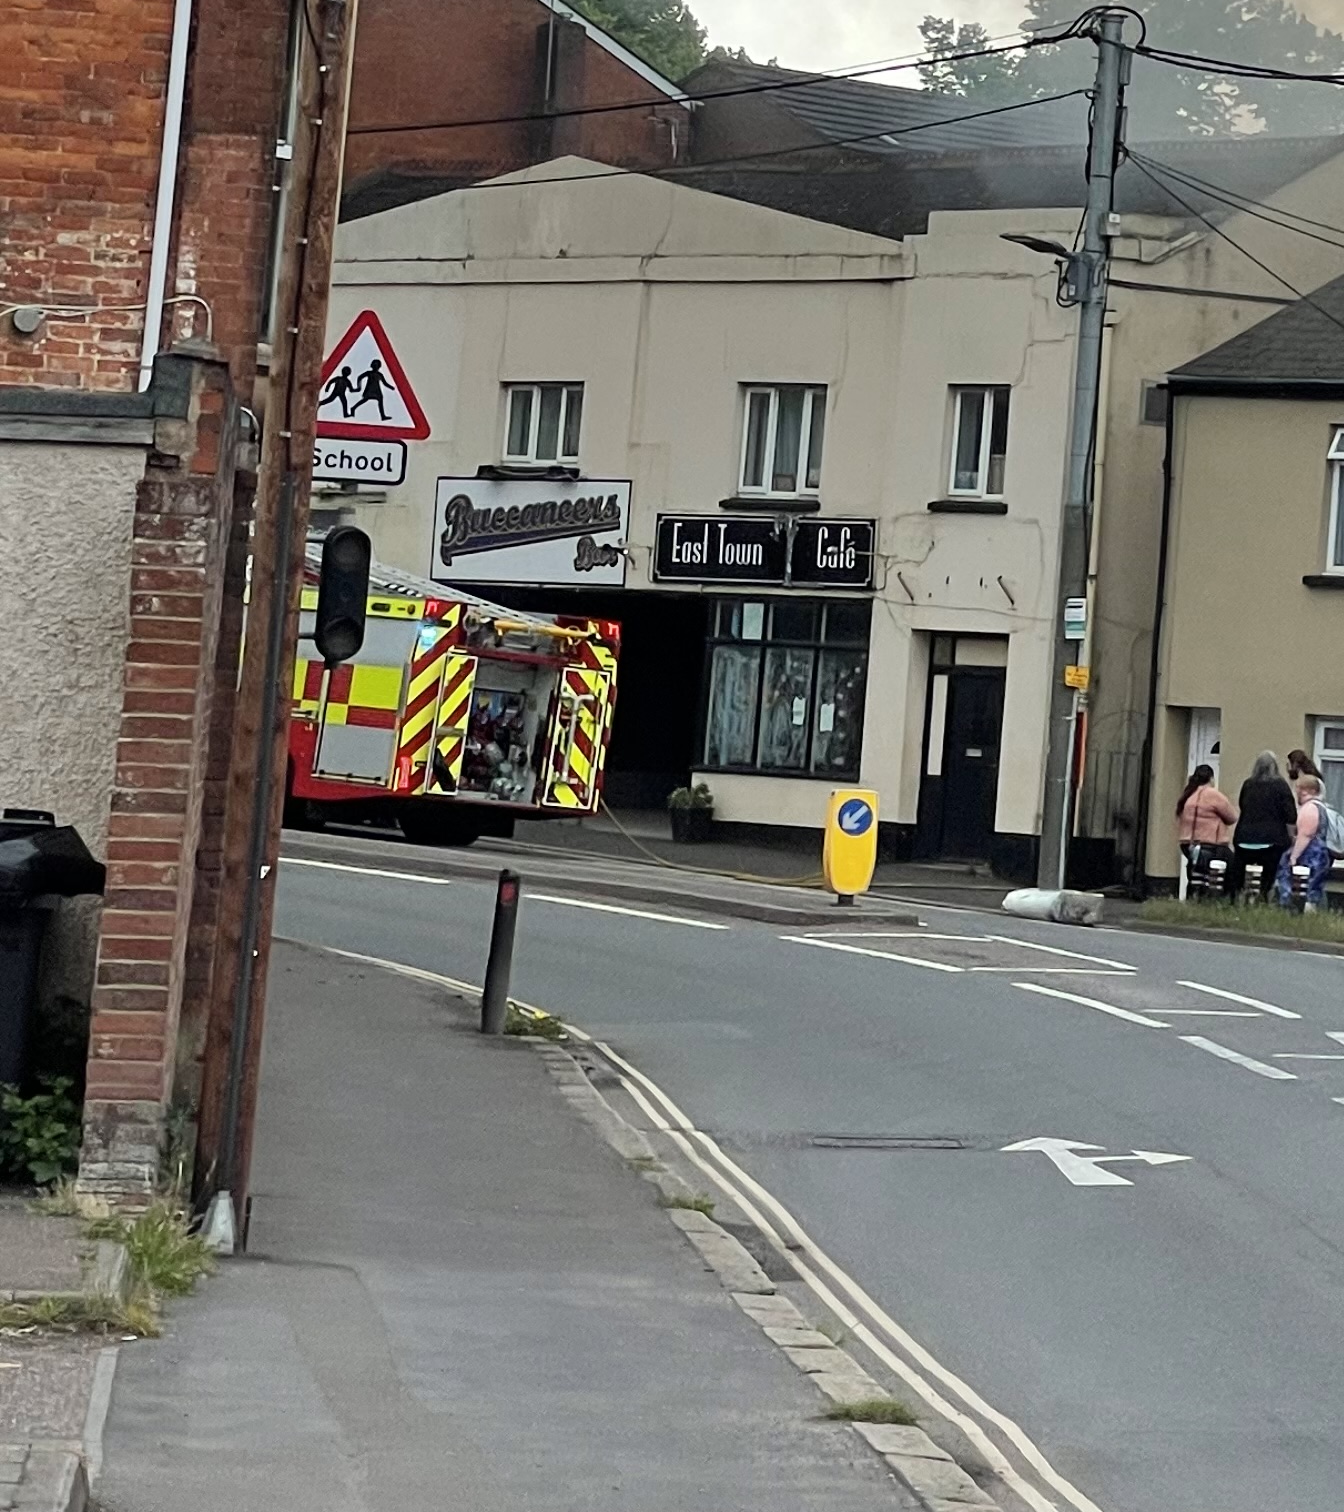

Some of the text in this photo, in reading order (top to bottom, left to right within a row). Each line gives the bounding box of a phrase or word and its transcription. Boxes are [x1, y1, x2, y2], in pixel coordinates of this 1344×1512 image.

[314, 448, 393, 472] School
[441, 493, 621, 546] Buccaneers
[574, 534, 619, 572] Bar
[671, 522, 763, 565] East Town
